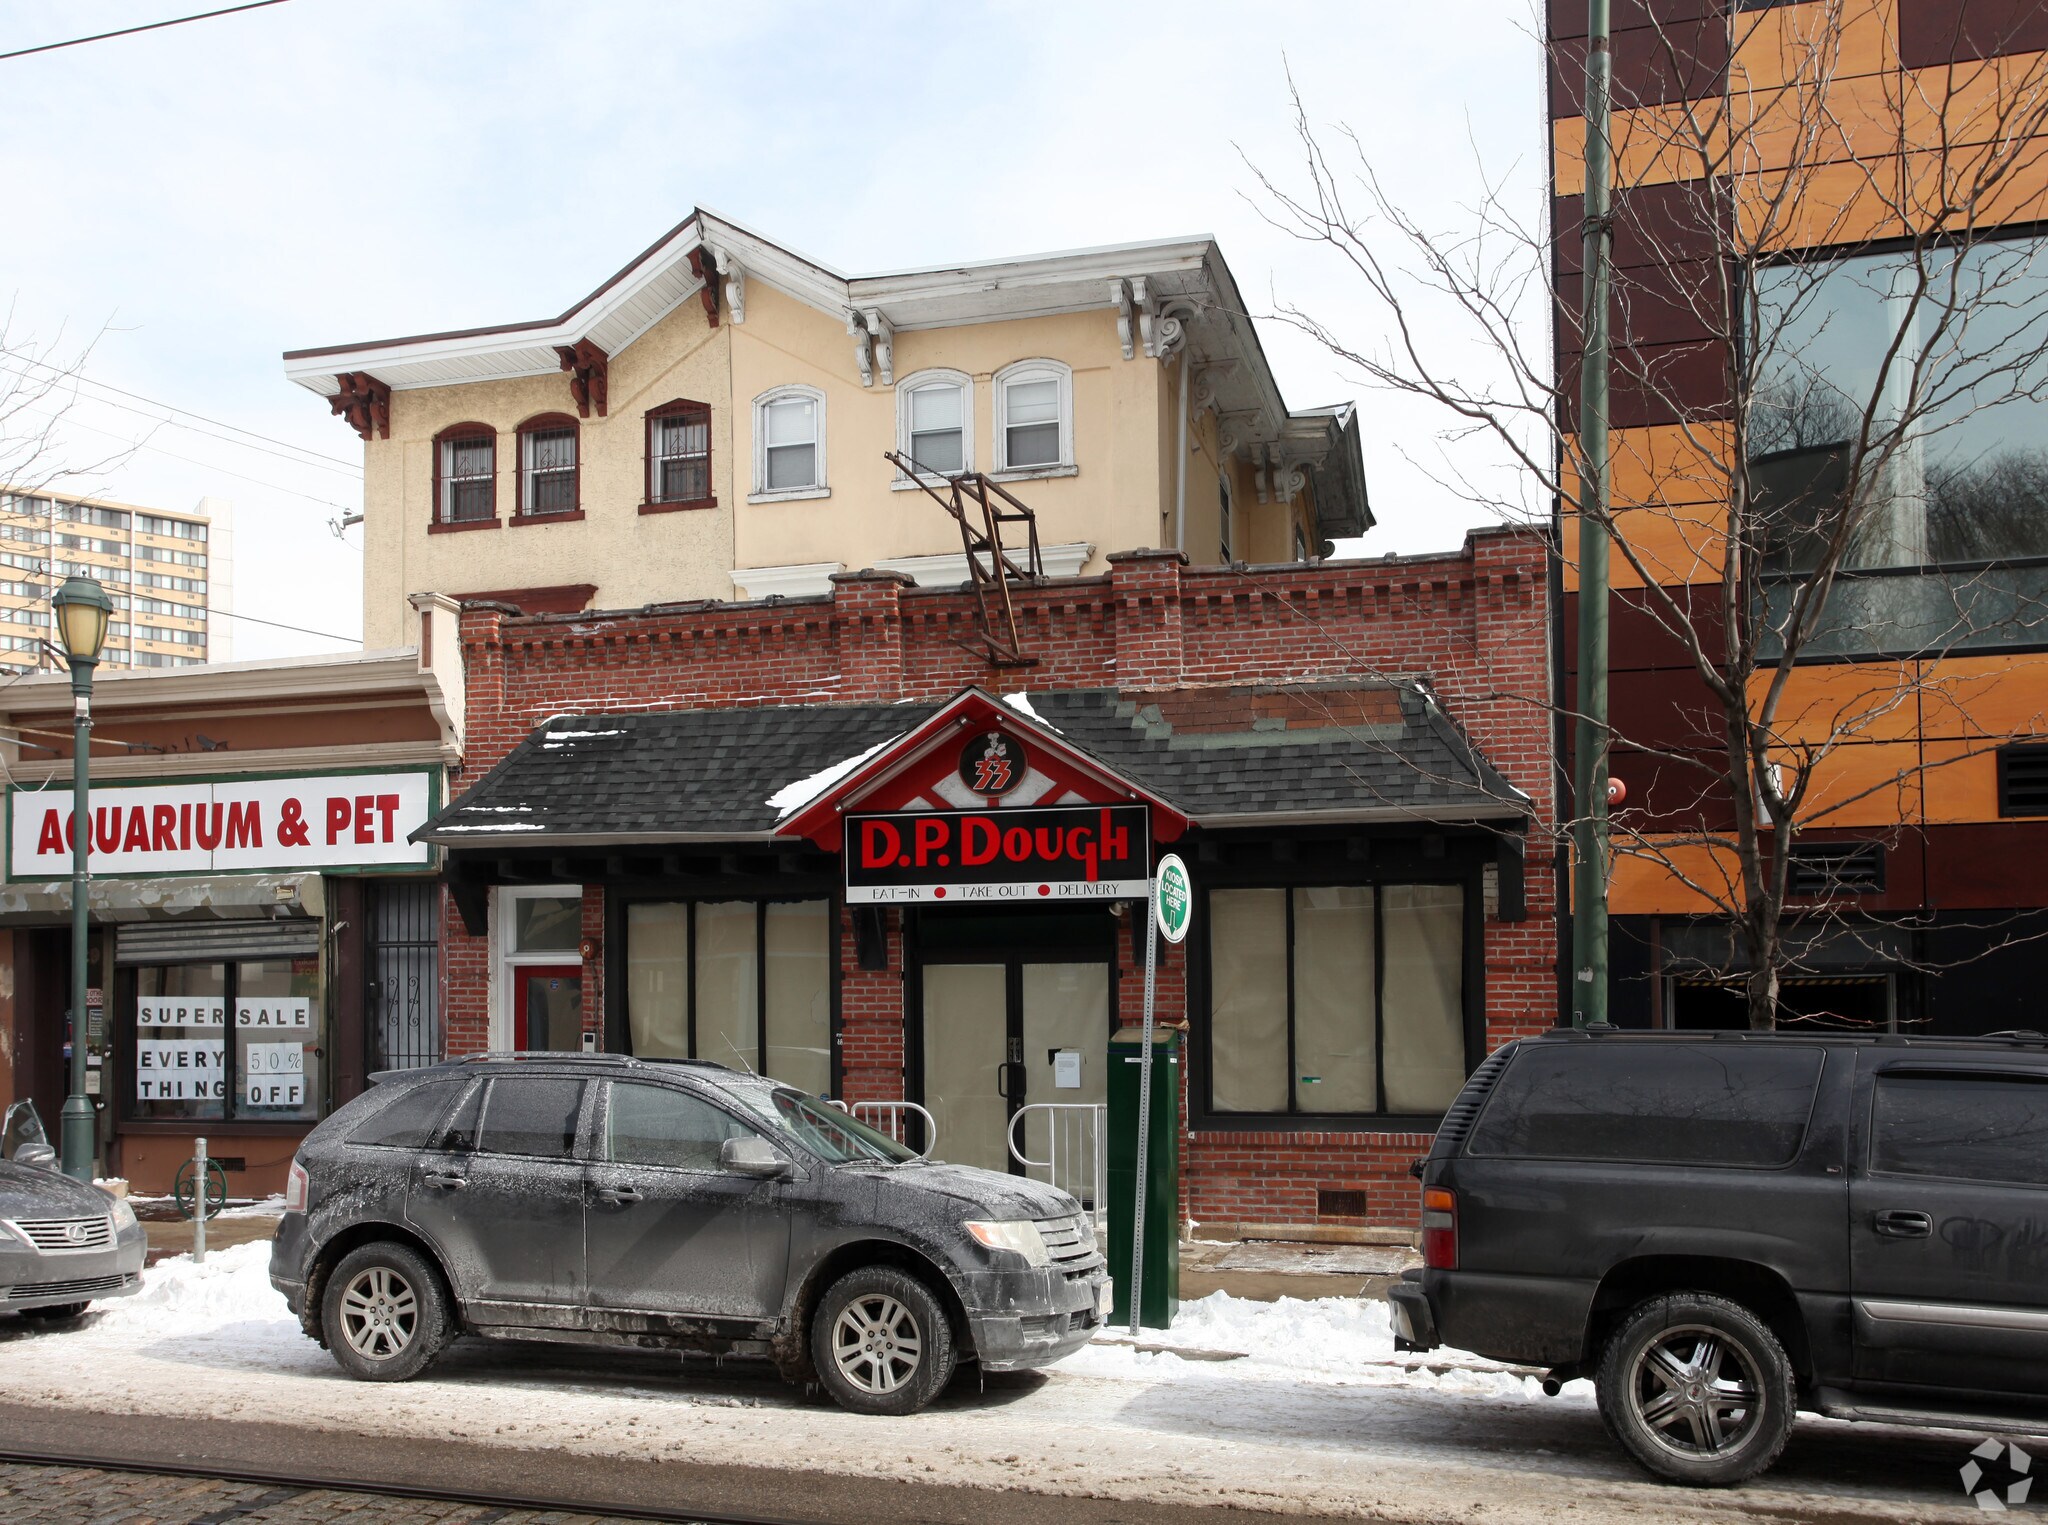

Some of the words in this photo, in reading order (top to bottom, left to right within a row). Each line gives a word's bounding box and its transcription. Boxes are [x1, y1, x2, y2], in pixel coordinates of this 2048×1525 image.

[37, 800, 263, 856] AQUARIUM
[277, 797, 311, 848] &
[326, 793, 400, 846] PET
[861, 818, 950, 869] D.P.
[1165, 869, 1183, 888] KIOSK
[872, 888, 920, 900] EAT-IN
[959, 886, 993, 898] TAKE
[998, 885, 1029, 897] OUT
[1058, 883, 1120, 896] DELIVERY
[1161, 880, 1186, 902] LOCATED
[1166, 894, 1181, 912] HERE
[141, 1007, 224, 1024] SUPER
[239, 1009, 306, 1025] SALE
[141, 1051, 225, 1068] EVERY
[141, 1081, 225, 1097] THING
[251, 1086, 299, 1103] OFF
